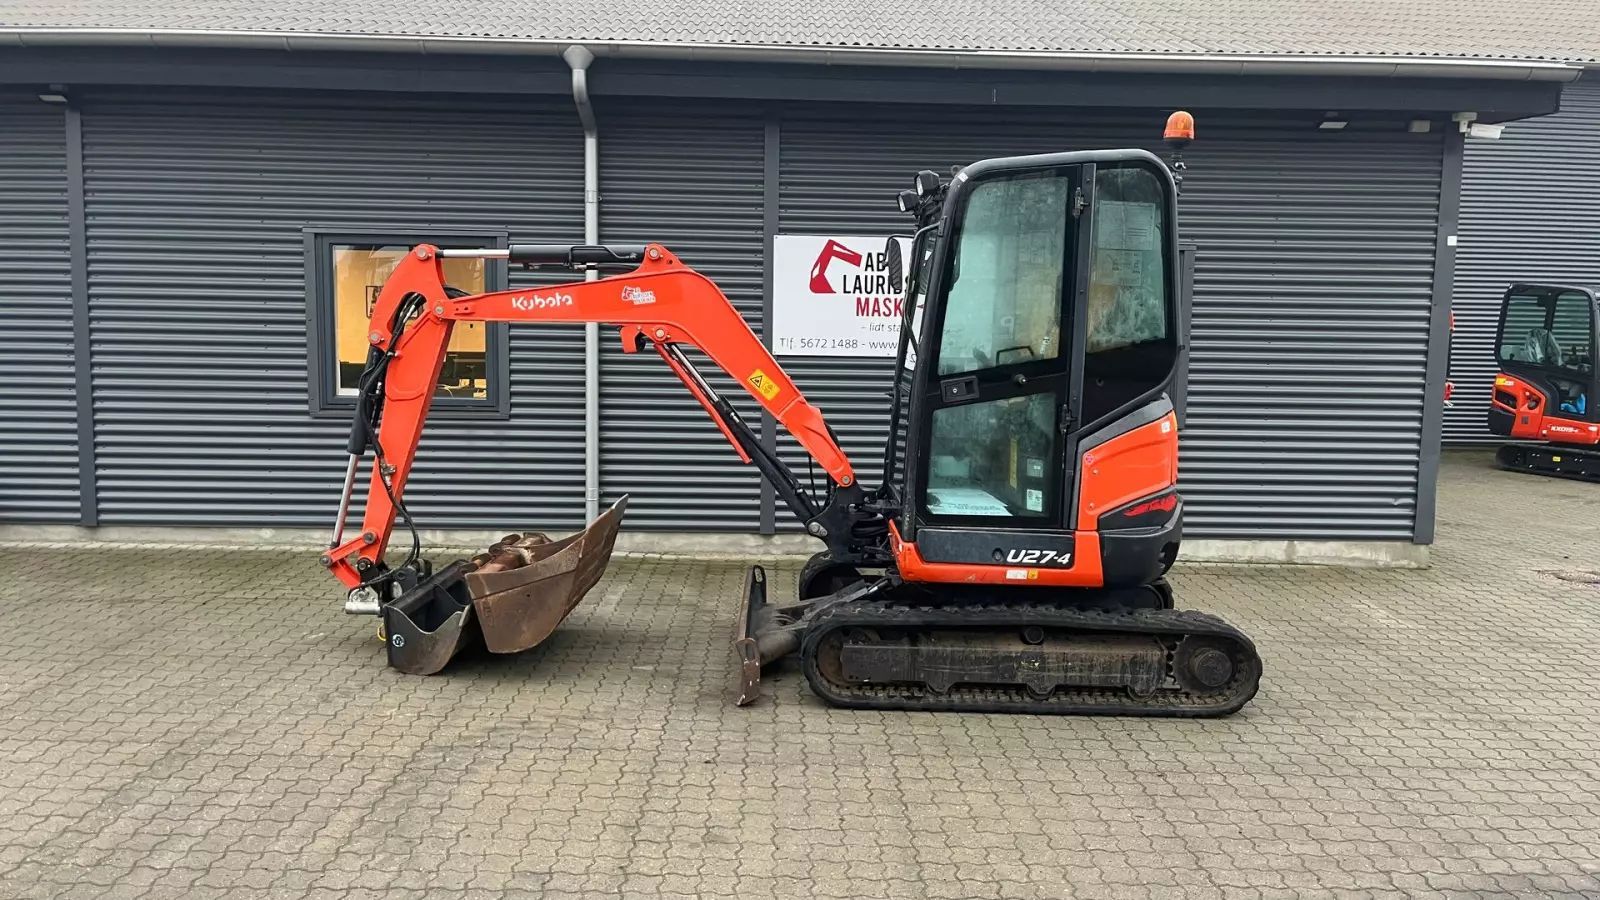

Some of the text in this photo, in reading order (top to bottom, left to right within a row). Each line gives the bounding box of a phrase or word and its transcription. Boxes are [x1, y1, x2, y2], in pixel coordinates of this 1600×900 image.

[865, 252, 887, 272] AB
[511, 292, 573, 310] Kubota
[856, 297, 905, 316] MASK
[869, 322, 885, 332] lidt
[887, 323, 901, 332] sta
[800, 338, 828, 349] 5672
[831, 339, 858, 349] 1488
[869, 341, 899, 349] www
[1006, 549, 1072, 565] U27-4
